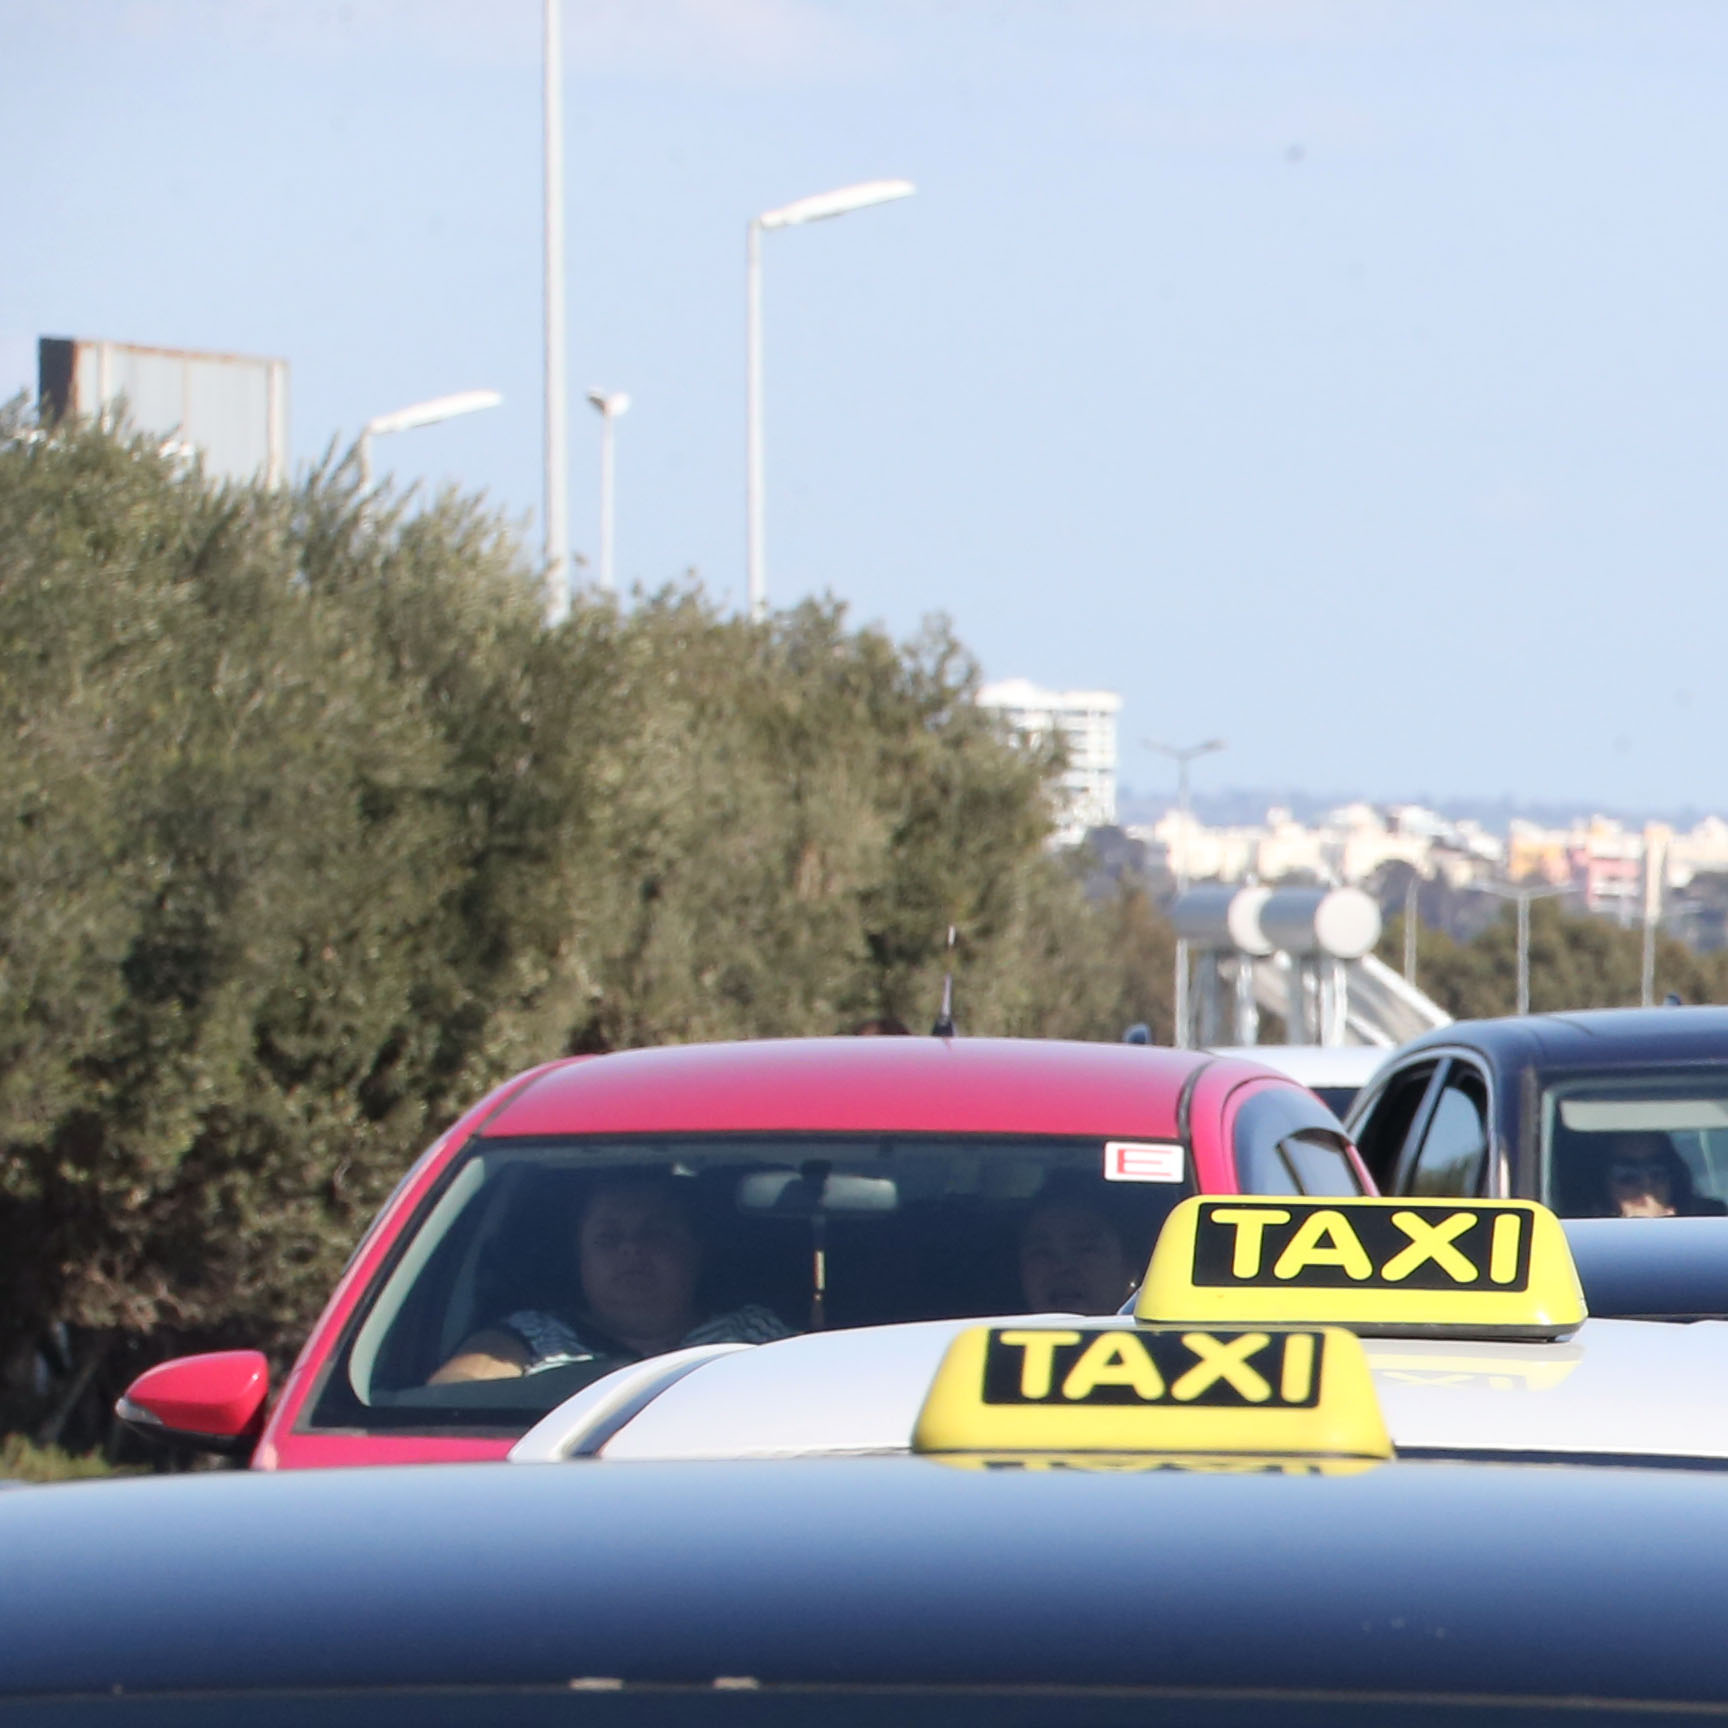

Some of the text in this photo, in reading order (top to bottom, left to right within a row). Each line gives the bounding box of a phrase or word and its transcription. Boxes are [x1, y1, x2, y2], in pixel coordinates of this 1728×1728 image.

[1116, 1149, 1172, 1176] E
[1211, 1209, 1521, 1285] TAXI
[1000, 1331, 1314, 1402] TAXI
